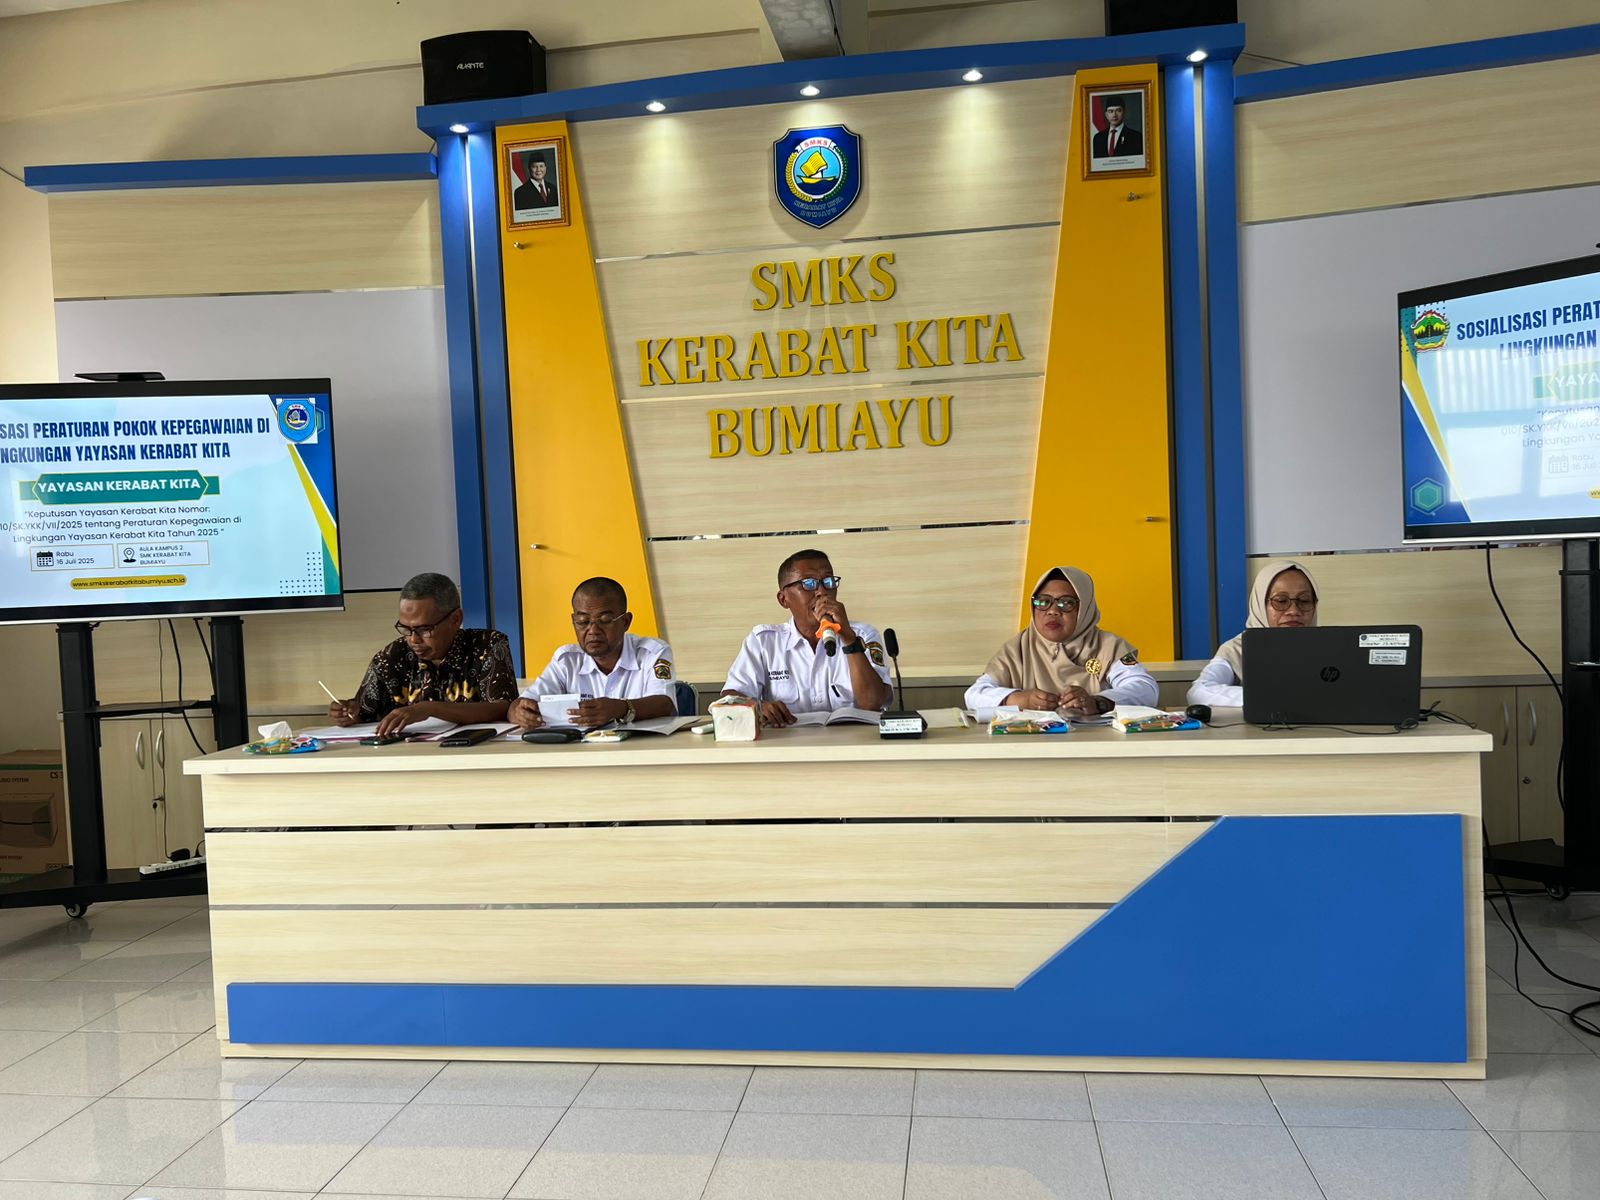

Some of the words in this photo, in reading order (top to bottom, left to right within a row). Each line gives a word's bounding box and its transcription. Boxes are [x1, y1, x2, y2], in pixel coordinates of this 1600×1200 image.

[750, 251, 897, 311] SMKS
[1456, 308, 1547, 341] SOSIALISASI
[1552, 300, 1600, 326] PERAT
[636, 323, 877, 387] KERABAT
[895, 312, 1025, 370] KITA
[1500, 329, 1597, 360] LINGKUNGAN
[33, 421, 110, 439] PERATURAN
[113, 420, 158, 437] POKOK
[161, 418, 253, 436] KEPEGAWAIAN
[257, 417, 270, 434] DI
[706, 394, 954, 459] BUMIAYU
[75, 444, 137, 462] YAYASAN
[140, 443, 197, 460] KERABAT
[202, 442, 230, 458] KITA
[38, 481, 104, 493] YAYASAN
[106, 480, 168, 491] KERABAT
[170, 478, 200, 490] KITA
[79, 508, 118, 518] Yayasan
[121, 507, 157, 515] Kerabat
[159, 506, 176, 514] Kita
[178, 506, 211, 514] Nomor:
[85, 521, 121, 530] tentang
[123, 519, 168, 527] Peraturan
[170, 517, 231, 527] Kepegawaian
[233, 515, 242, 523] di
[13, 533, 66, 544] Lingkungan
[68, 533, 108, 542] Yayasan
[110, 531, 146, 540] Kerabat
[148, 530, 165, 538] Kita
[167, 529, 195, 537] Tahun
[197, 528, 219, 536] 2025
[56, 550, 75, 558] Rabu
